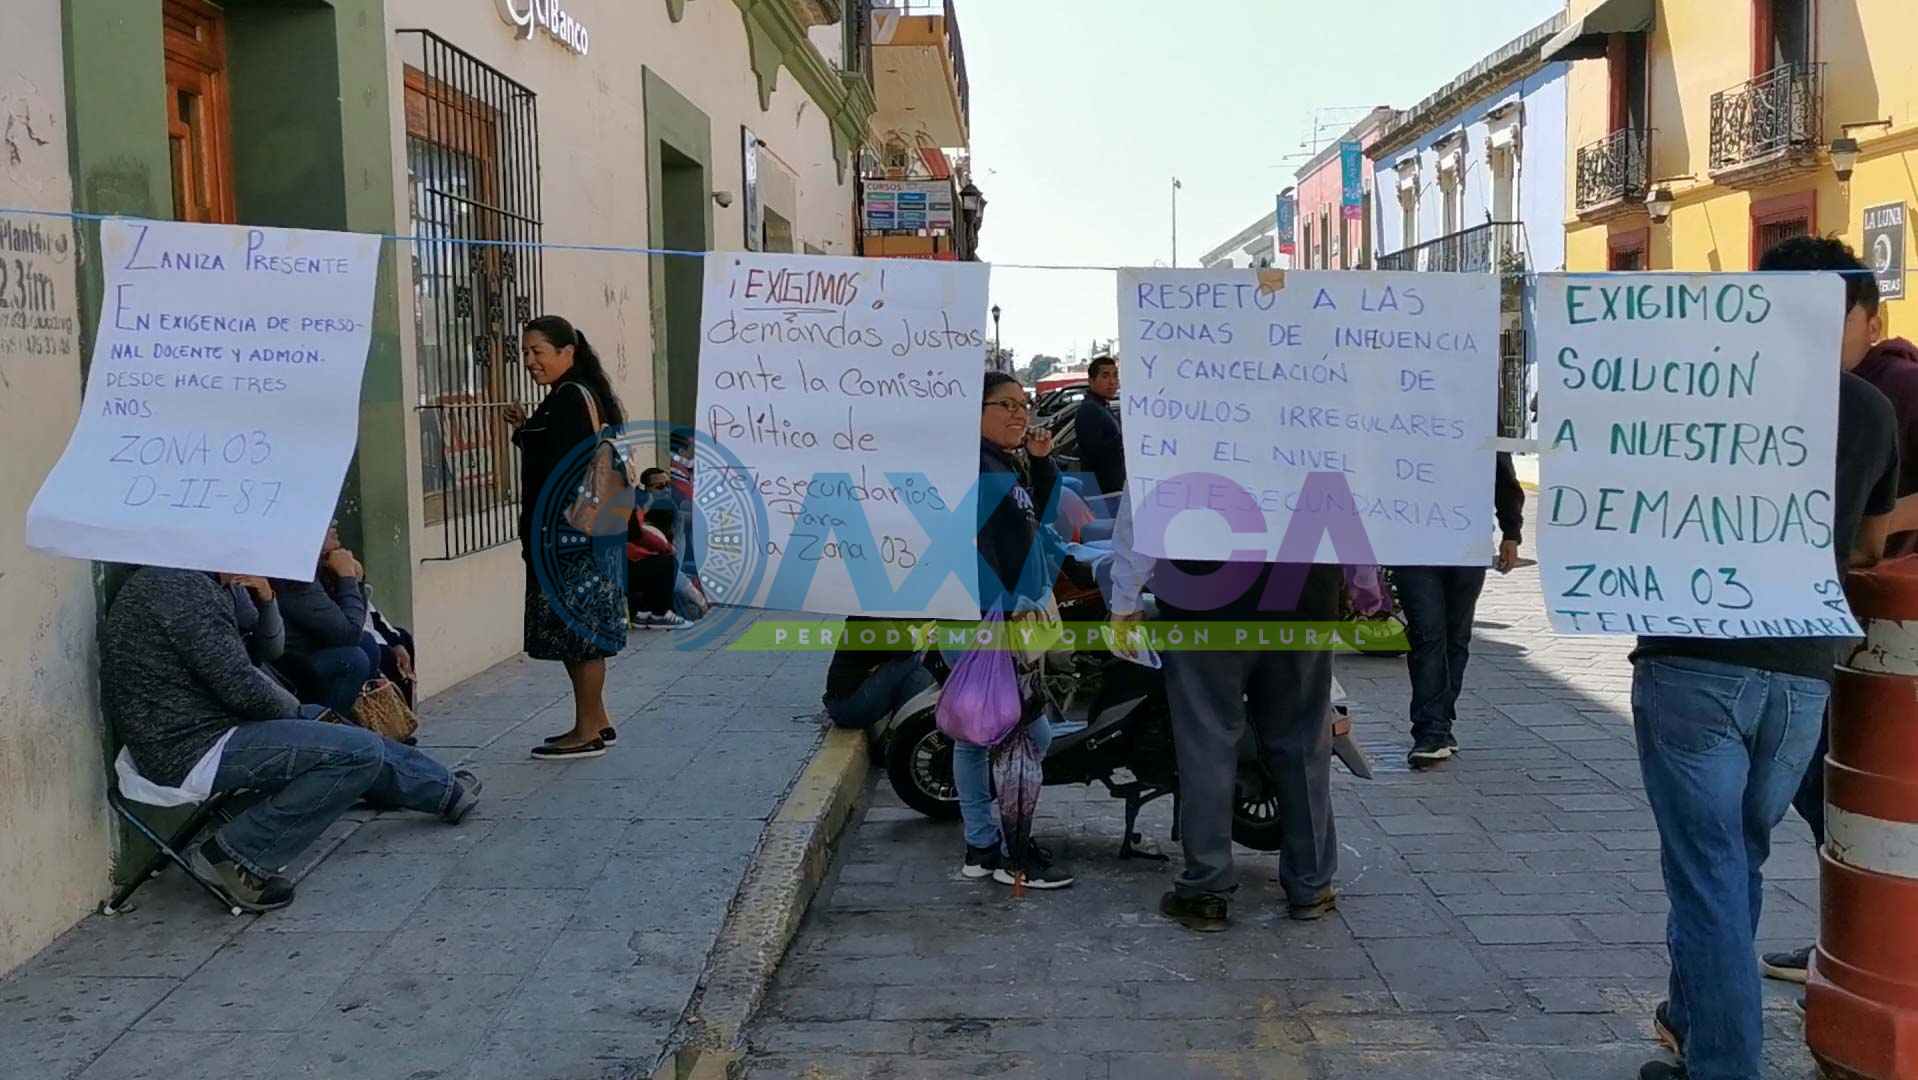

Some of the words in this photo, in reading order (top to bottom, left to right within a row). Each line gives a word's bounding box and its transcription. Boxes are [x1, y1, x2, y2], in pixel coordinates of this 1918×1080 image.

[1864, 211, 1876, 230] LA
[1877, 207, 1903, 228] LUNA
[125, 224, 225, 271] ZANIZA
[246, 229, 349, 275] PRESENTE
[115, 283, 150, 331] EN
[160, 313, 256, 332] EXIGENCIA
[267, 316, 289, 332] DE
[301, 317, 366, 333] PERSO-
[1137, 282, 1276, 311] RESPETO
[1313, 287, 1337, 311] A
[1361, 286, 1425, 315] LAS
[1566, 283, 1771, 325] EXIGIMOS
[707, 309, 884, 349] demandas
[1139, 318, 1233, 346] ZONAS
[1269, 323, 1302, 348] DE
[1335, 326, 1479, 354] INFLUENCIA
[110, 343, 144, 361] NAL
[153, 342, 224, 361] DOCENTE
[231, 348, 241, 363] Y
[1140, 354, 1159, 379] Y
[1177, 353, 1348, 385] CANCELACIÓN
[1401, 368, 1437, 393] DE
[1557, 346, 1760, 399] SOLUCIÓN
[106, 371, 166, 389] DESDE
[175, 373, 224, 391] HACE
[232, 376, 288, 393] TRES
[715, 354, 786, 393] ante
[799, 359, 829, 394] la
[839, 368, 967, 399] Comisión
[708, 403, 819, 445] Política
[833, 405, 879, 451] de
[1128, 386, 1251, 425] MÓDULOS
[1281, 405, 1466, 440] IRREGULARES
[109, 434, 210, 465] ZONA
[223, 429, 273, 465] 03
[1141, 434, 1177, 458] EN
[1213, 440, 1251, 463] EL
[1272, 444, 1357, 474] NIVEL
[1396, 457, 1436, 484] DE
[1552, 418, 1578, 453] A
[1610, 421, 1808, 467] NUESTRAS
[708, 464, 946, 511] Telesecundarias
[1134, 474, 1473, 532] TELESECUNDARIAS
[768, 499, 847, 528] Para
[1548, 484, 1832, 549] DEMANDAS
[788, 533, 867, 561] Zona
[1561, 563, 1664, 602] ZONA
[1691, 567, 1754, 610] 03
